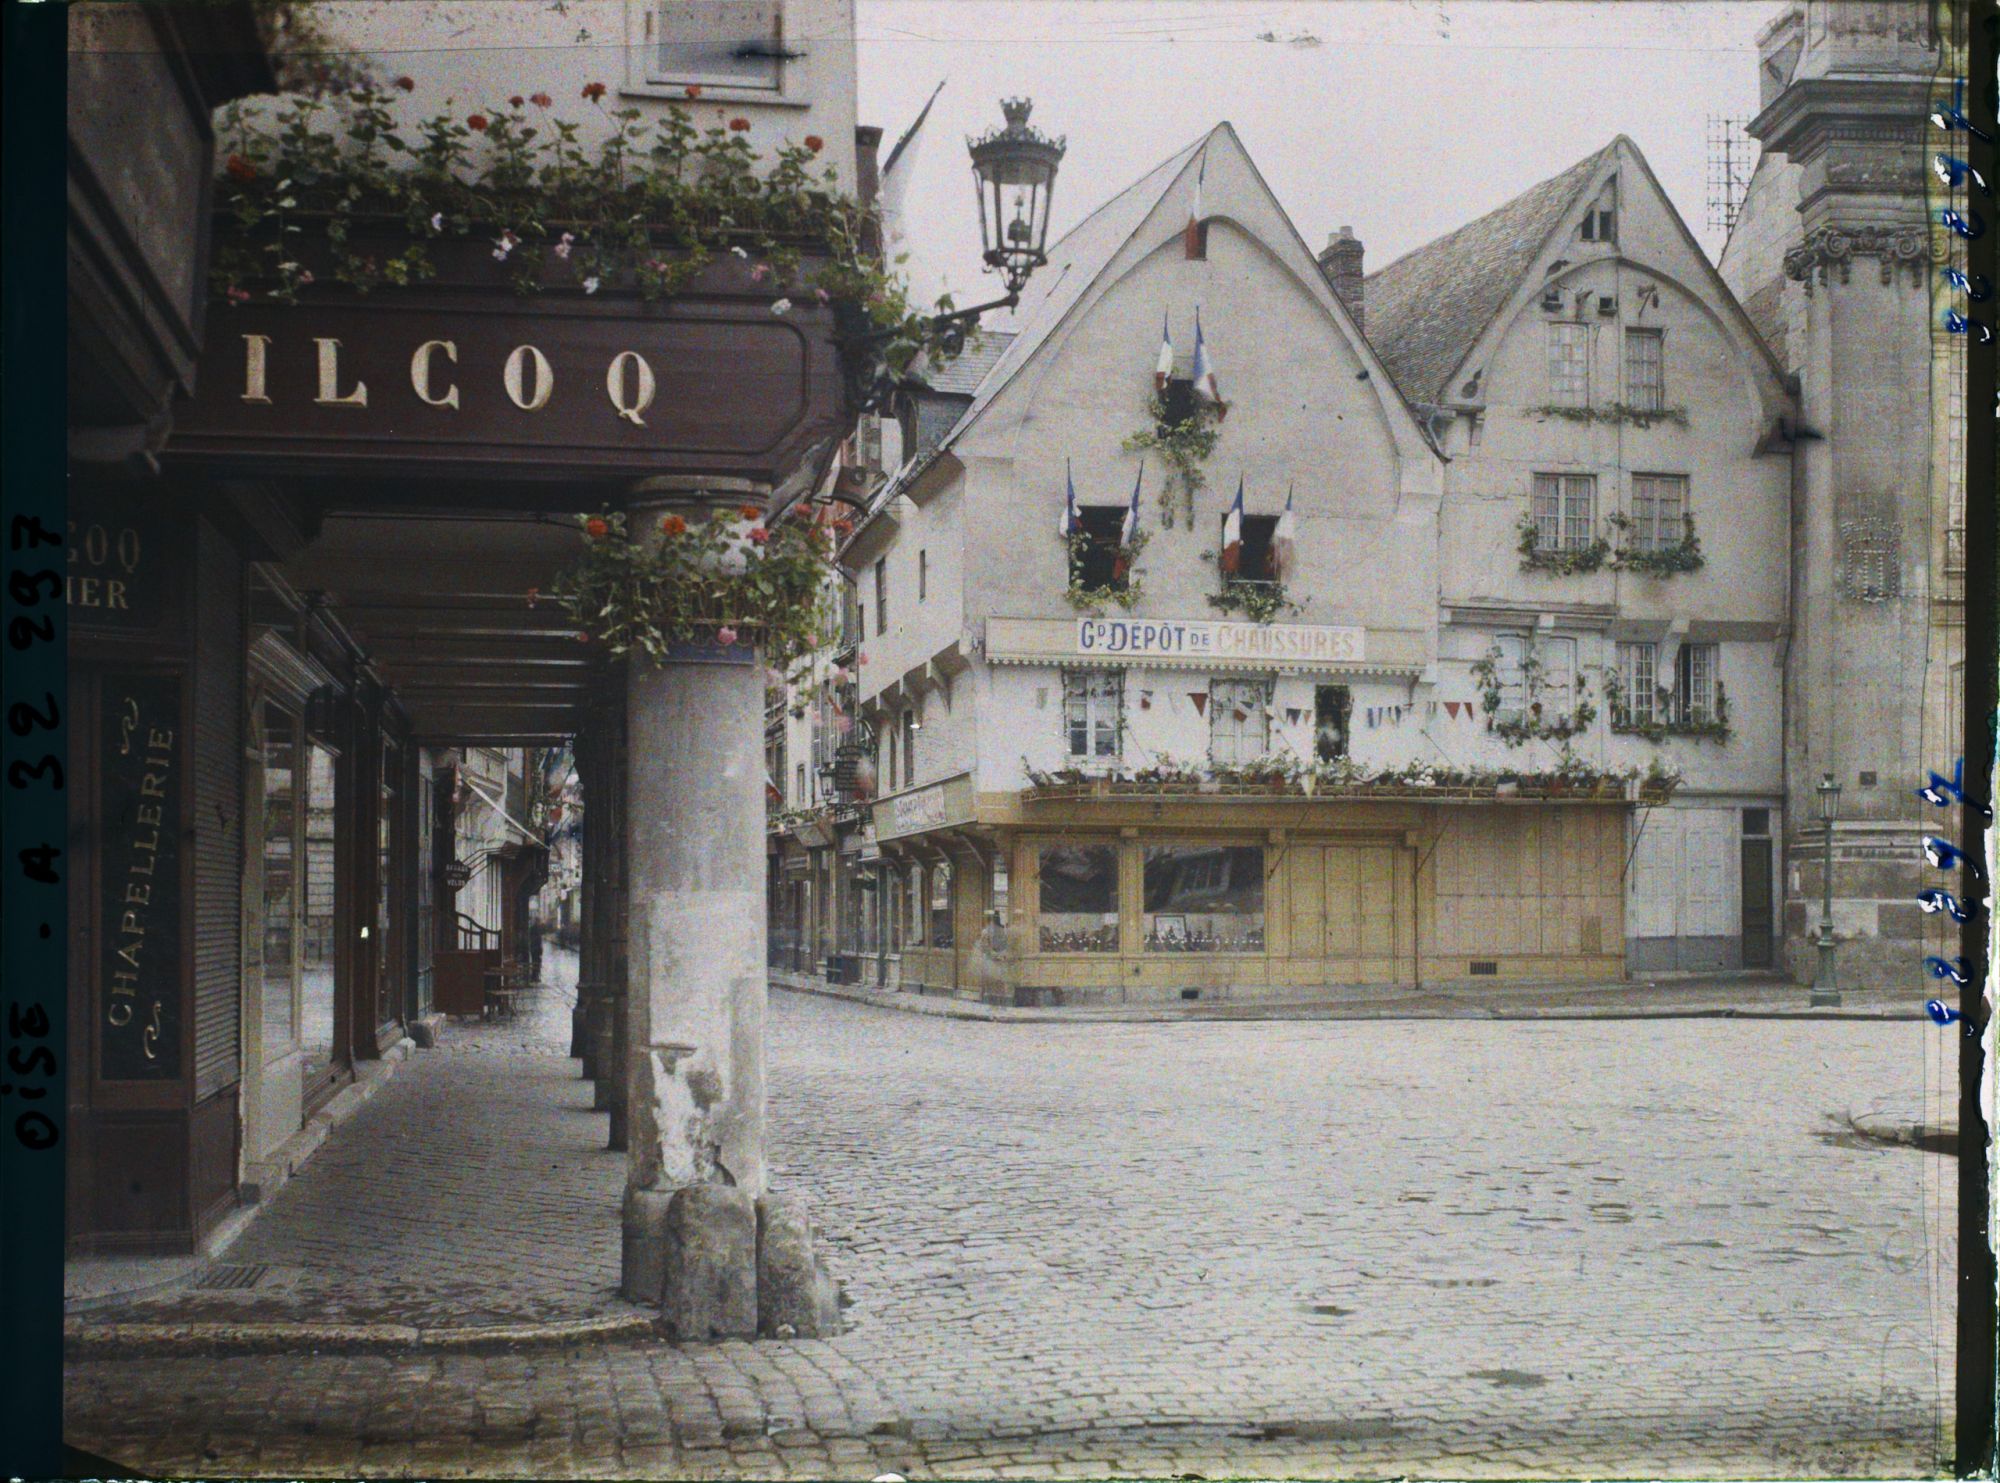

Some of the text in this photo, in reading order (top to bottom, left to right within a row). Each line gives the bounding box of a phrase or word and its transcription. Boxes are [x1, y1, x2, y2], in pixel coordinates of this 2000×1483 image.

[240, 333, 657, 427] ILCOQ
[1108, 620, 1186, 652] DÉPÔT
[1191, 632, 1210, 646] DE
[1217, 625, 1355, 658] CHAUSSURES
[108, 727, 173, 1026] CHAPELLERIE
